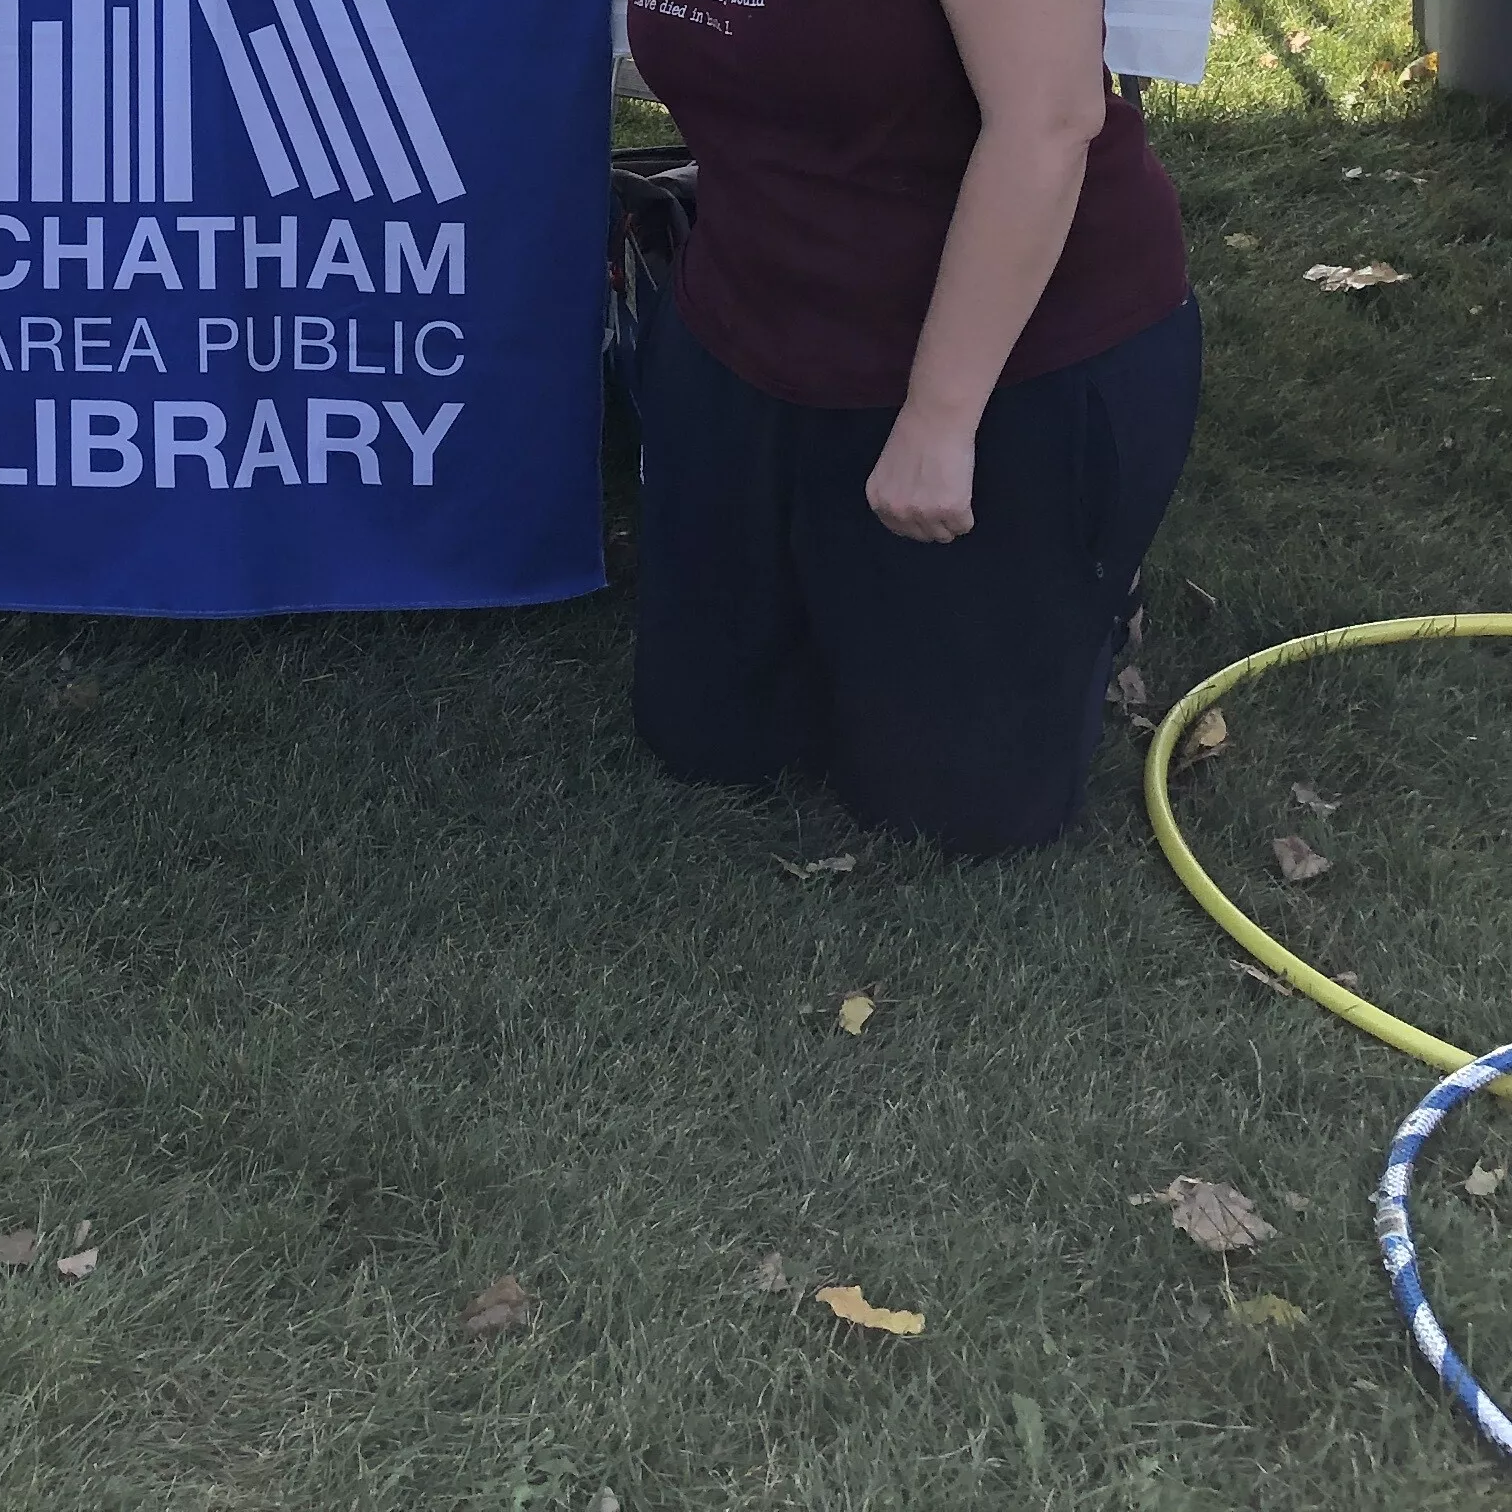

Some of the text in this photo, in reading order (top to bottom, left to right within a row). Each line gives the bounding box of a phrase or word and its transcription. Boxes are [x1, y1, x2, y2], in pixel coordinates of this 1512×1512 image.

[659, 0, 687, 18] died
[690, 8, 703, 24] in
[198, 315, 465, 376] PUBLIC
